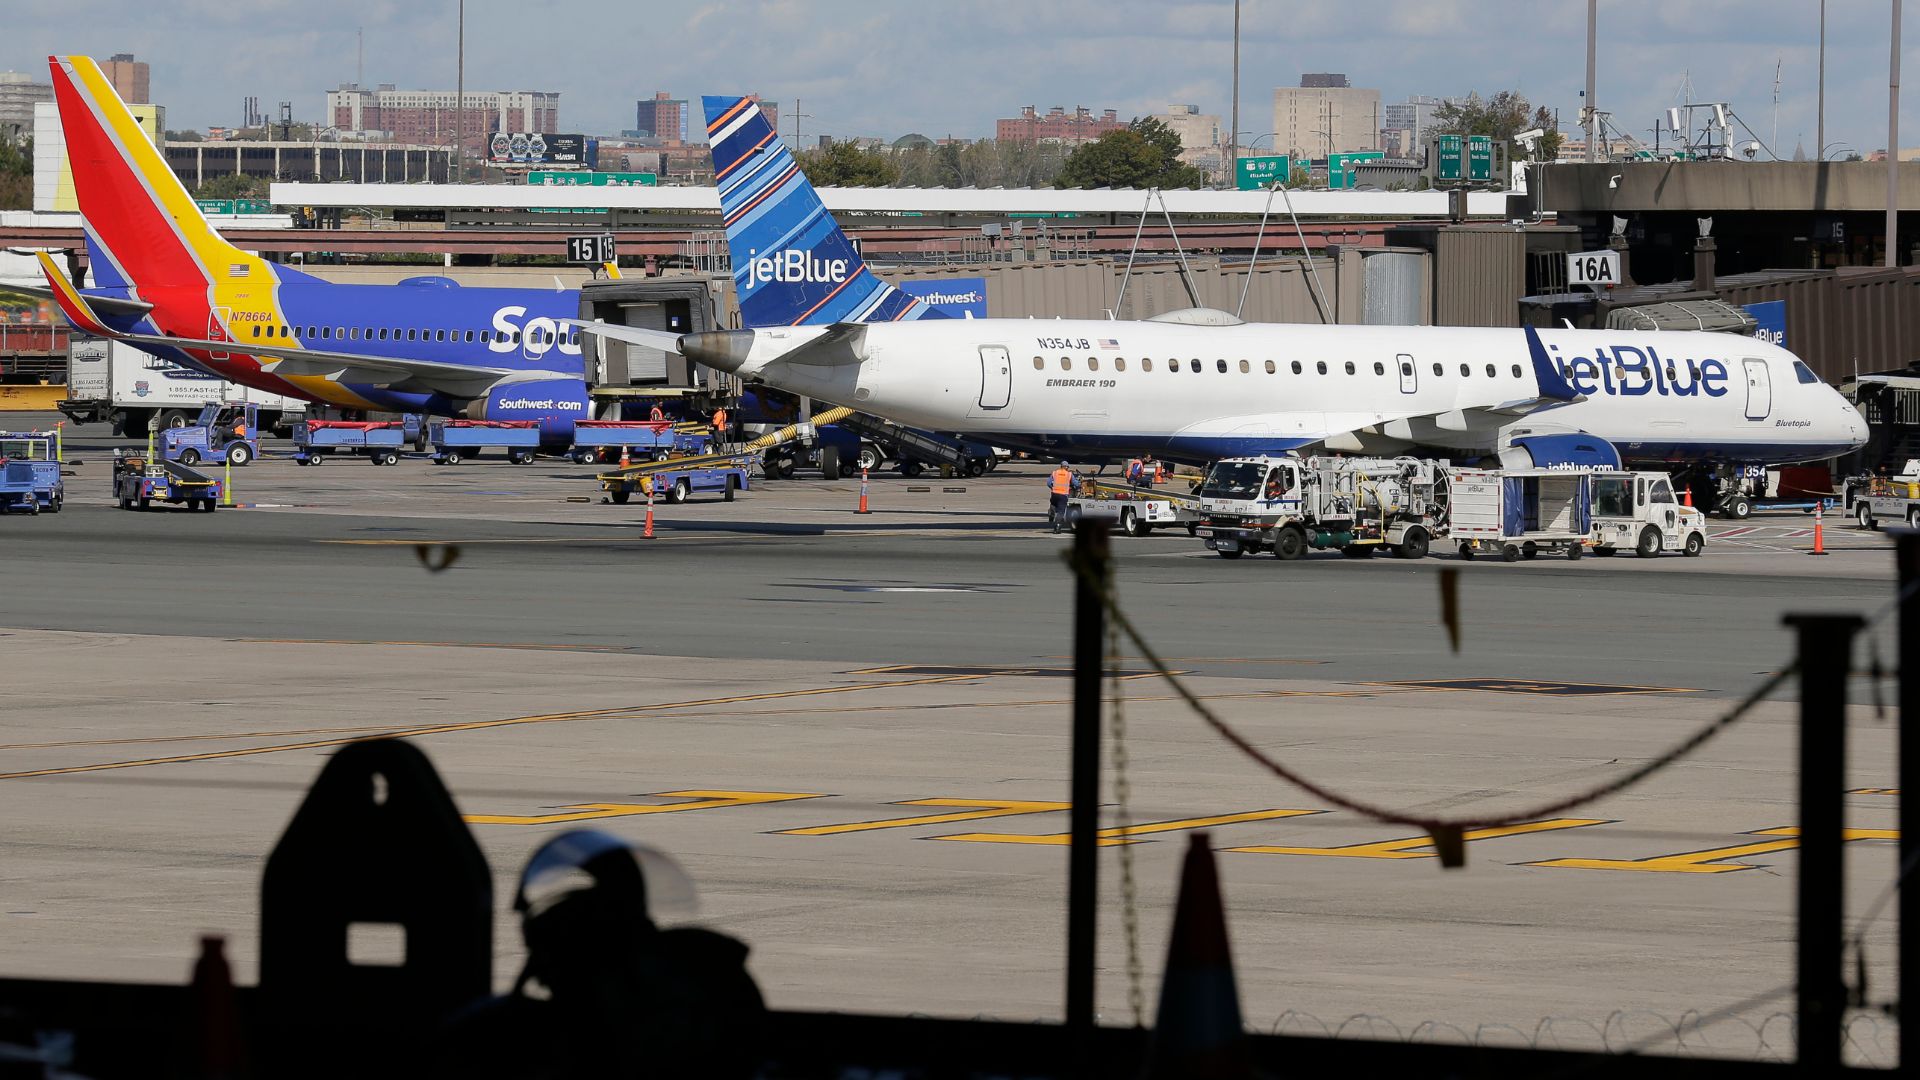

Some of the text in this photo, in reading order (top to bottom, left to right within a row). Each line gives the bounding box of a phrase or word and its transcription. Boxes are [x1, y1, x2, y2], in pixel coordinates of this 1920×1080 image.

[1831, 222, 1844, 238] 15
[572, 239, 593, 261] 15
[602, 237, 614, 261] 15
[746, 249, 847, 289] jetBlue
[1575, 256, 1613, 281] 16A
[907, 290, 977, 305] outhwest
[231, 311, 273, 322] N7866A
[1037, 337, 1091, 351] N354JB
[1046, 379, 1117, 388] EMBRAER 190
[1775, 419, 1812, 429] Bluetopia
[1746, 465, 1766, 477] 354
